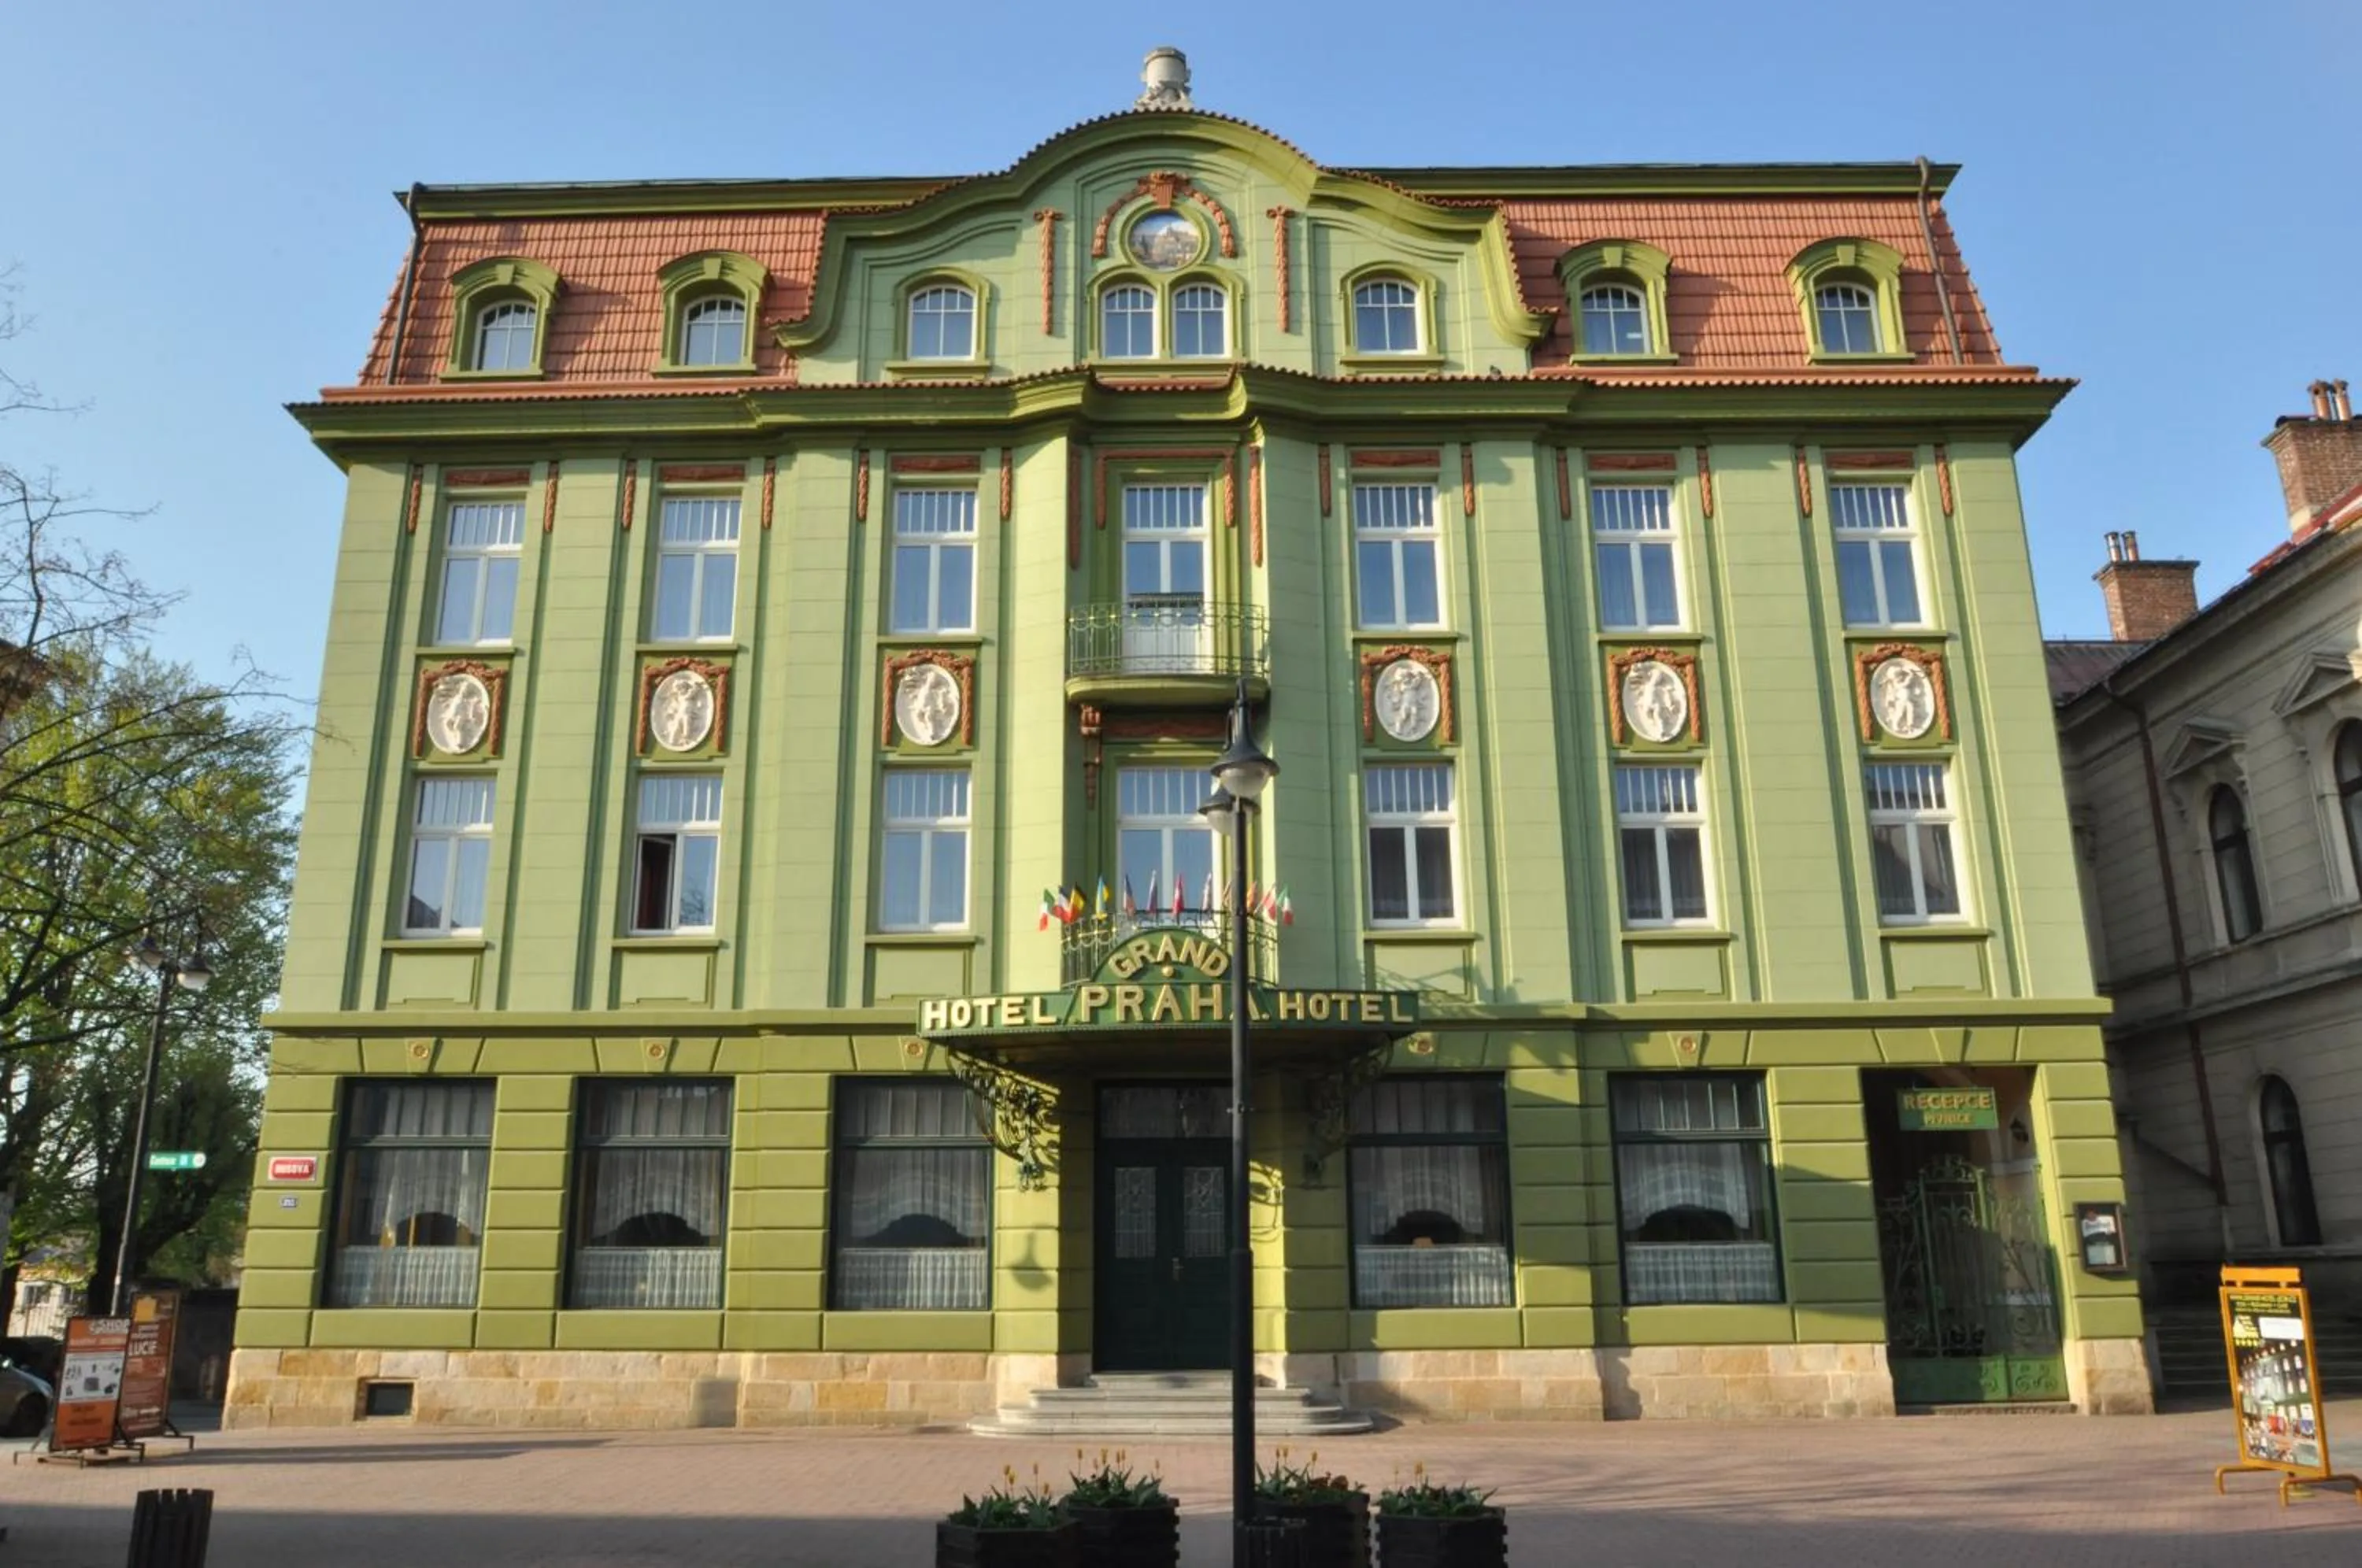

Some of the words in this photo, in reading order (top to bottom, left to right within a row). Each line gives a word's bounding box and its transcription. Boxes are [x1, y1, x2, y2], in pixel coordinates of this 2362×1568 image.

[1109, 934, 1229, 979] GRAND
[924, 995, 1057, 1029] HOTEL
[1279, 990, 1413, 1023] HOTEL
[1902, 1092, 1991, 1109] RECEPCE
